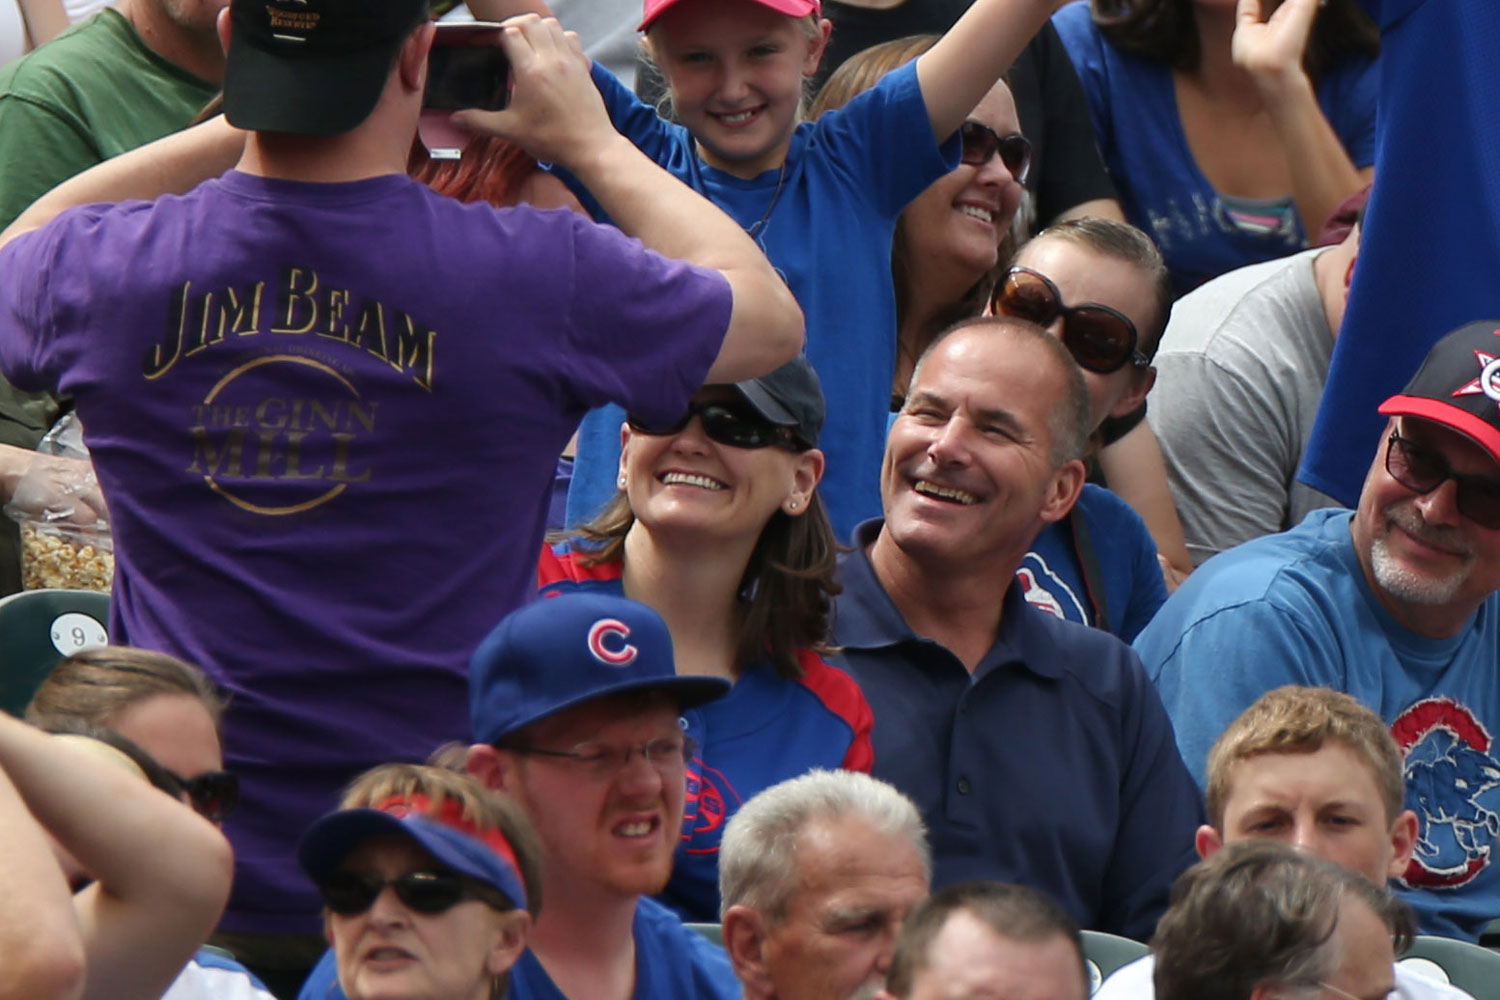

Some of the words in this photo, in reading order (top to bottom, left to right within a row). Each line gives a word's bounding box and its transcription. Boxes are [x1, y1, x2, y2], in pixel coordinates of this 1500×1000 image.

[143, 279, 265, 380] JIM
[270, 264, 438, 392] BEAM
[189, 402, 250, 428] THE
[255, 397, 379, 434] GINN
[184, 427, 372, 483] MILL
[71, 626, 86, 647] 9
[587, 618, 639, 667] C
